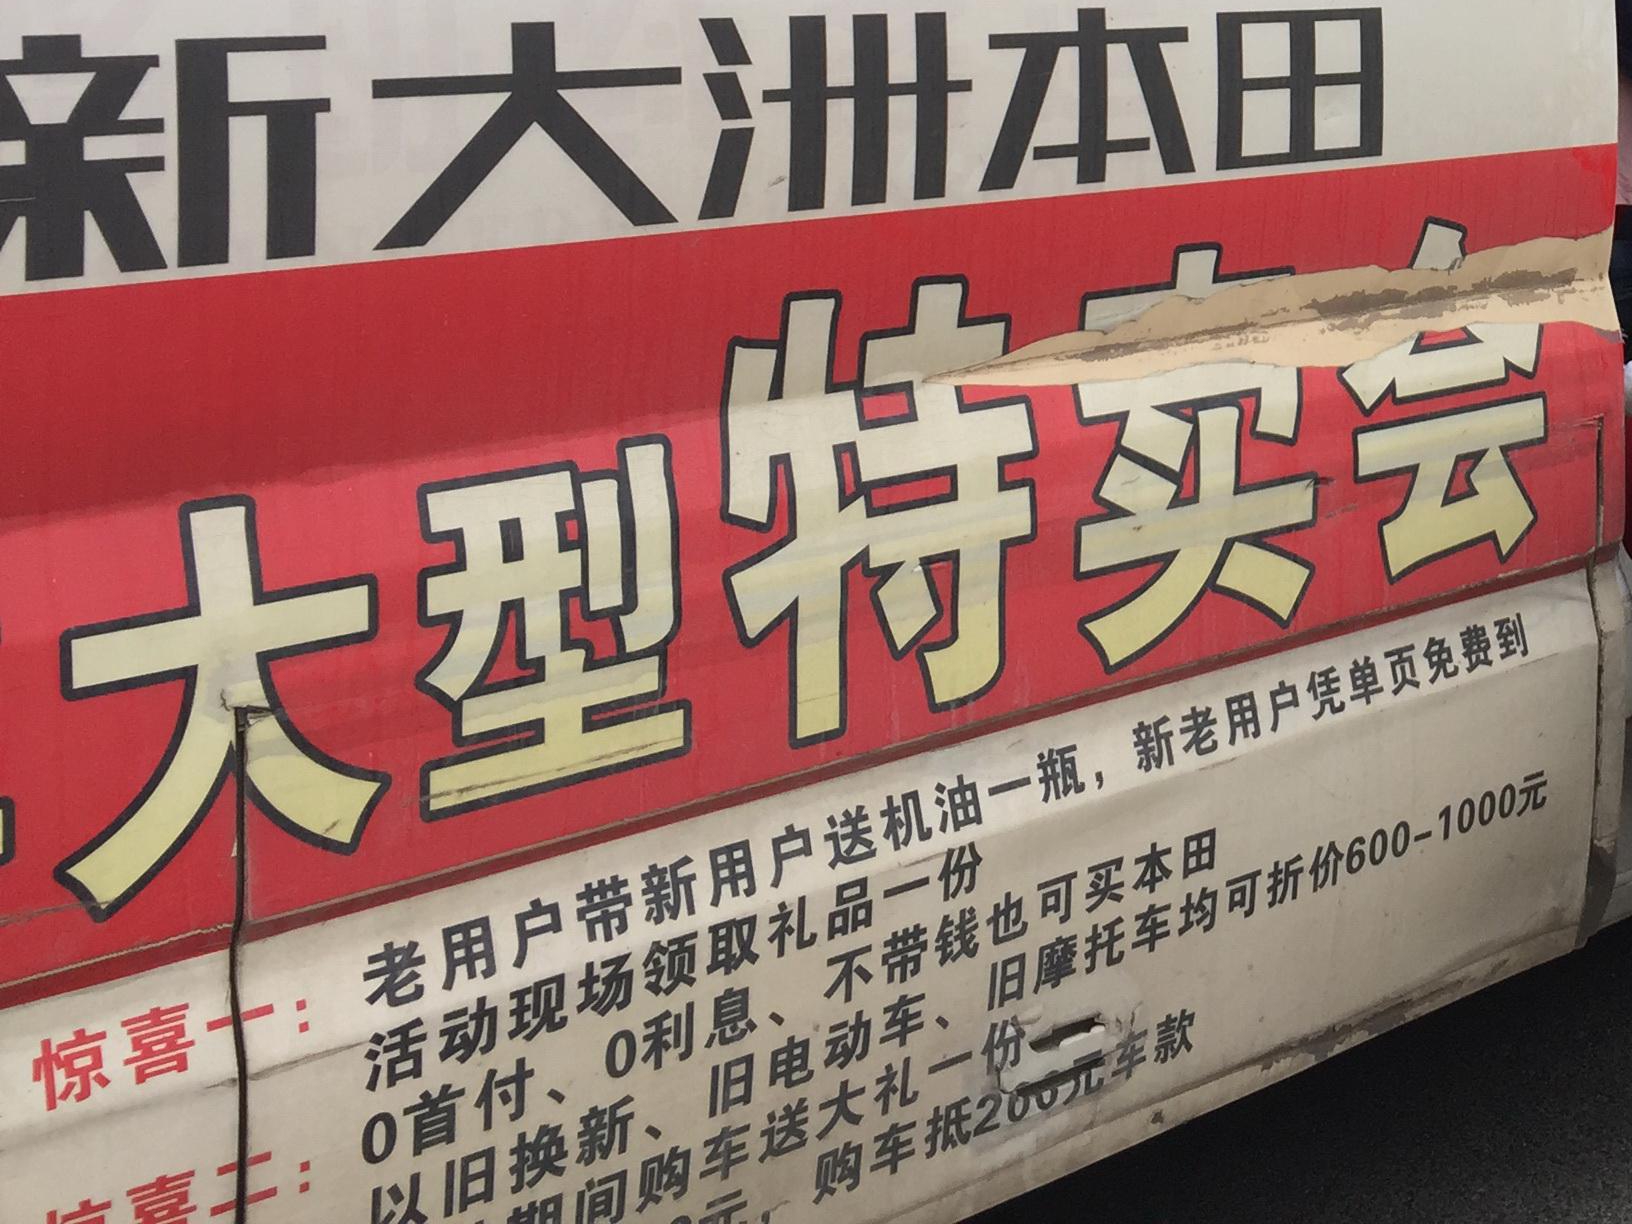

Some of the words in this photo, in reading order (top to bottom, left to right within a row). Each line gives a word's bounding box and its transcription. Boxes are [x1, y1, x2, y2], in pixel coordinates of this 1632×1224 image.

[0, 7, 1384, 283] 新大洲本田
[54, 218, 1548, 921] 大型特卖会
[364, 847, 984, 1092] 活动现场领取礼品一份
